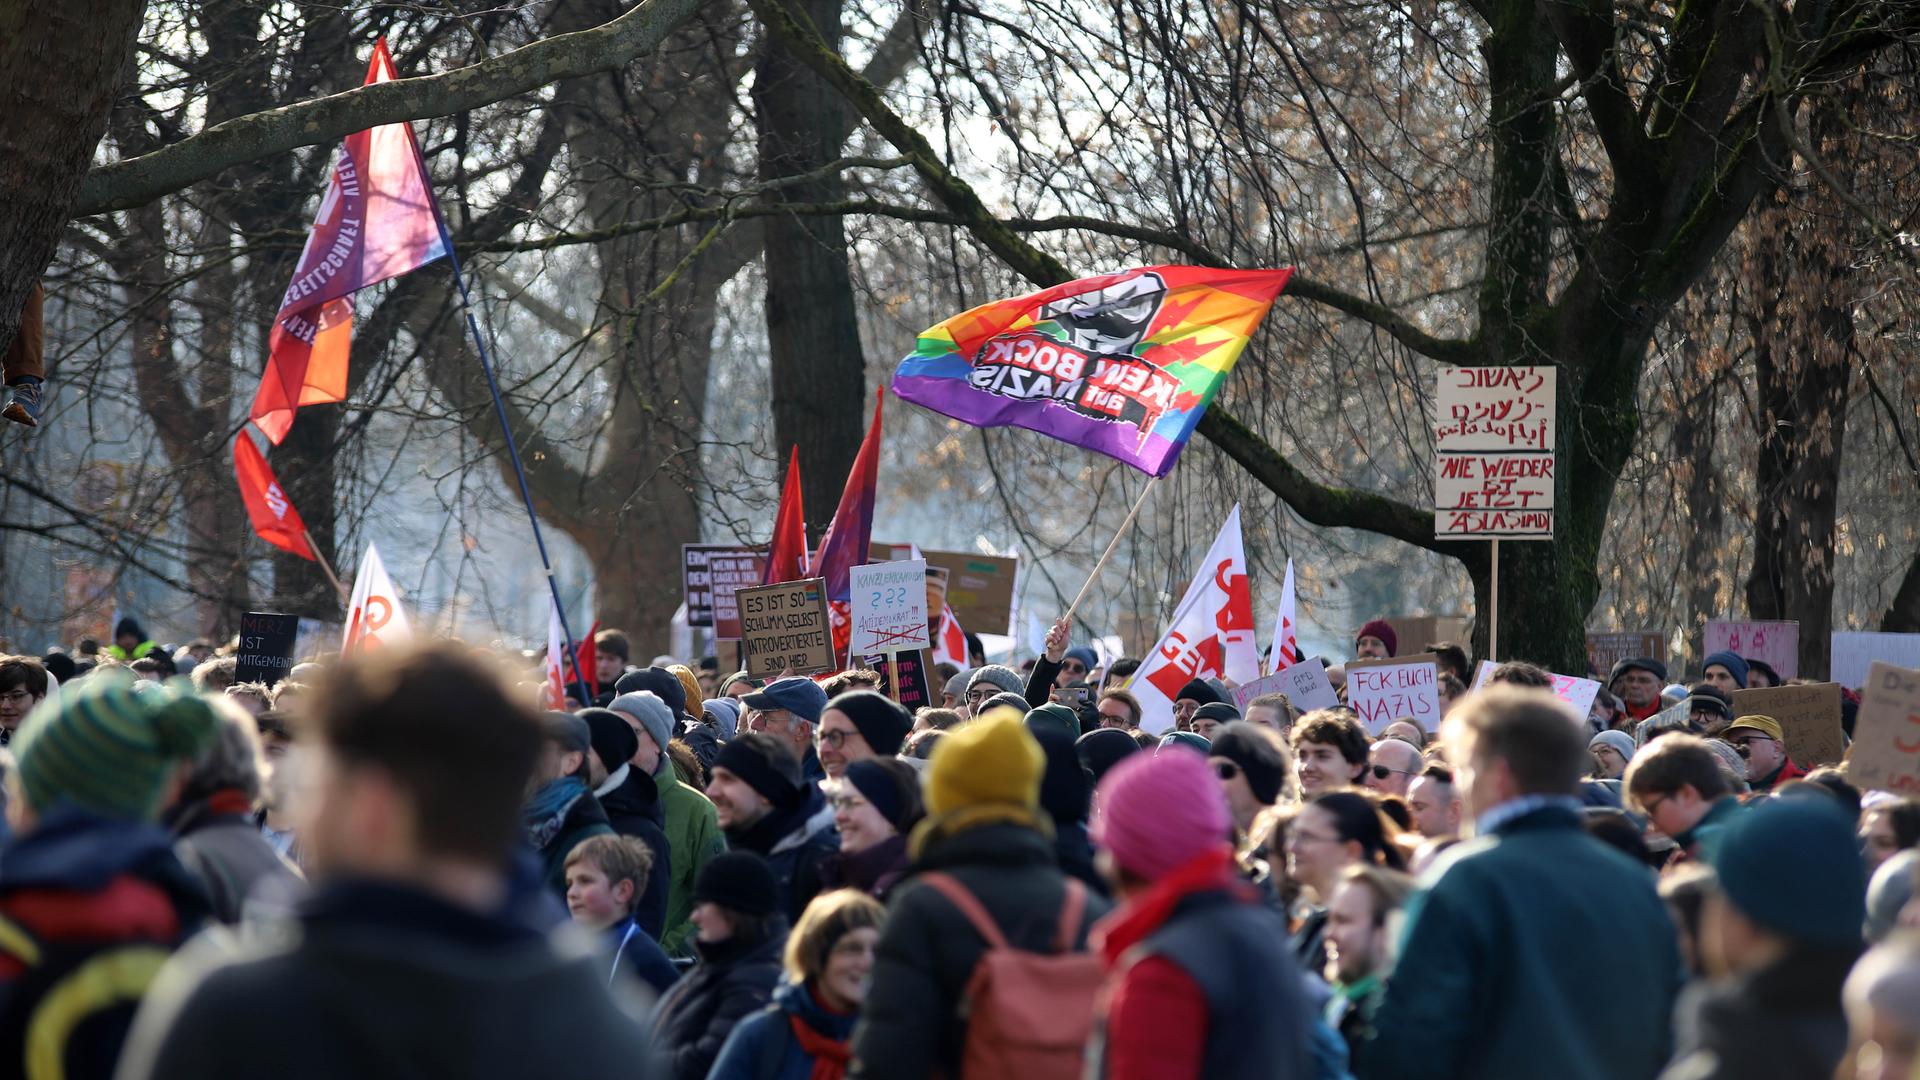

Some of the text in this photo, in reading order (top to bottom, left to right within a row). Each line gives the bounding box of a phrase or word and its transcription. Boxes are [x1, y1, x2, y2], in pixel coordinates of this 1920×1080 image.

[1481, 457, 1553, 479] WIEDER
[746, 597, 764, 613] ES
[767, 594, 785, 611] IST
[790, 591, 806, 608] SO
[240, 635, 264, 650] IST
[748, 630, 824, 656] INTROVERTIERTE
[875, 623, 922, 650] MERZ
[764, 653, 809, 671] SIND HIER
[1353, 667, 1433, 692] FCK EUCH
[1353, 693, 1432, 723] NAZIS
